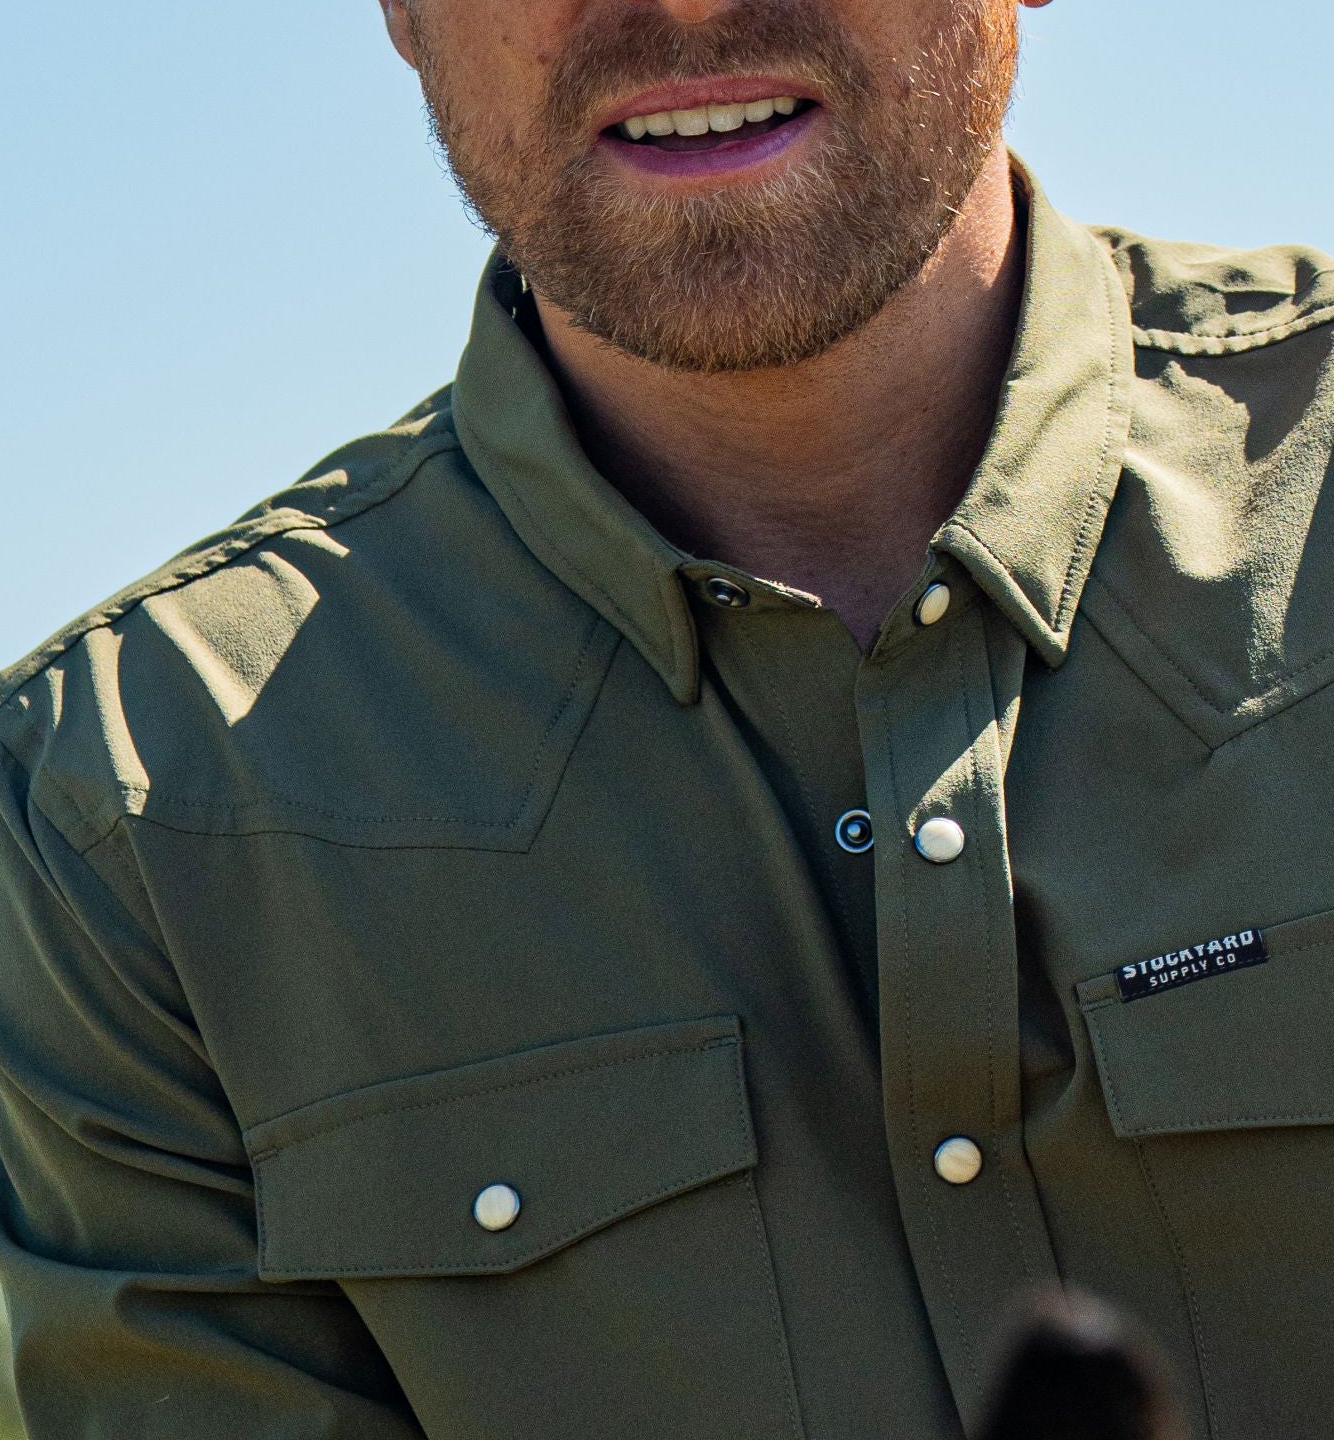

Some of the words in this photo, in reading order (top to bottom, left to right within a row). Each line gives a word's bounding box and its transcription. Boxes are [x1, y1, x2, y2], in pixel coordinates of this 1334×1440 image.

[1122, 930, 1255, 980] STOCKYARD
[1149, 960, 1208, 987] SUPPLY
[1216, 953, 1236, 966] CO
